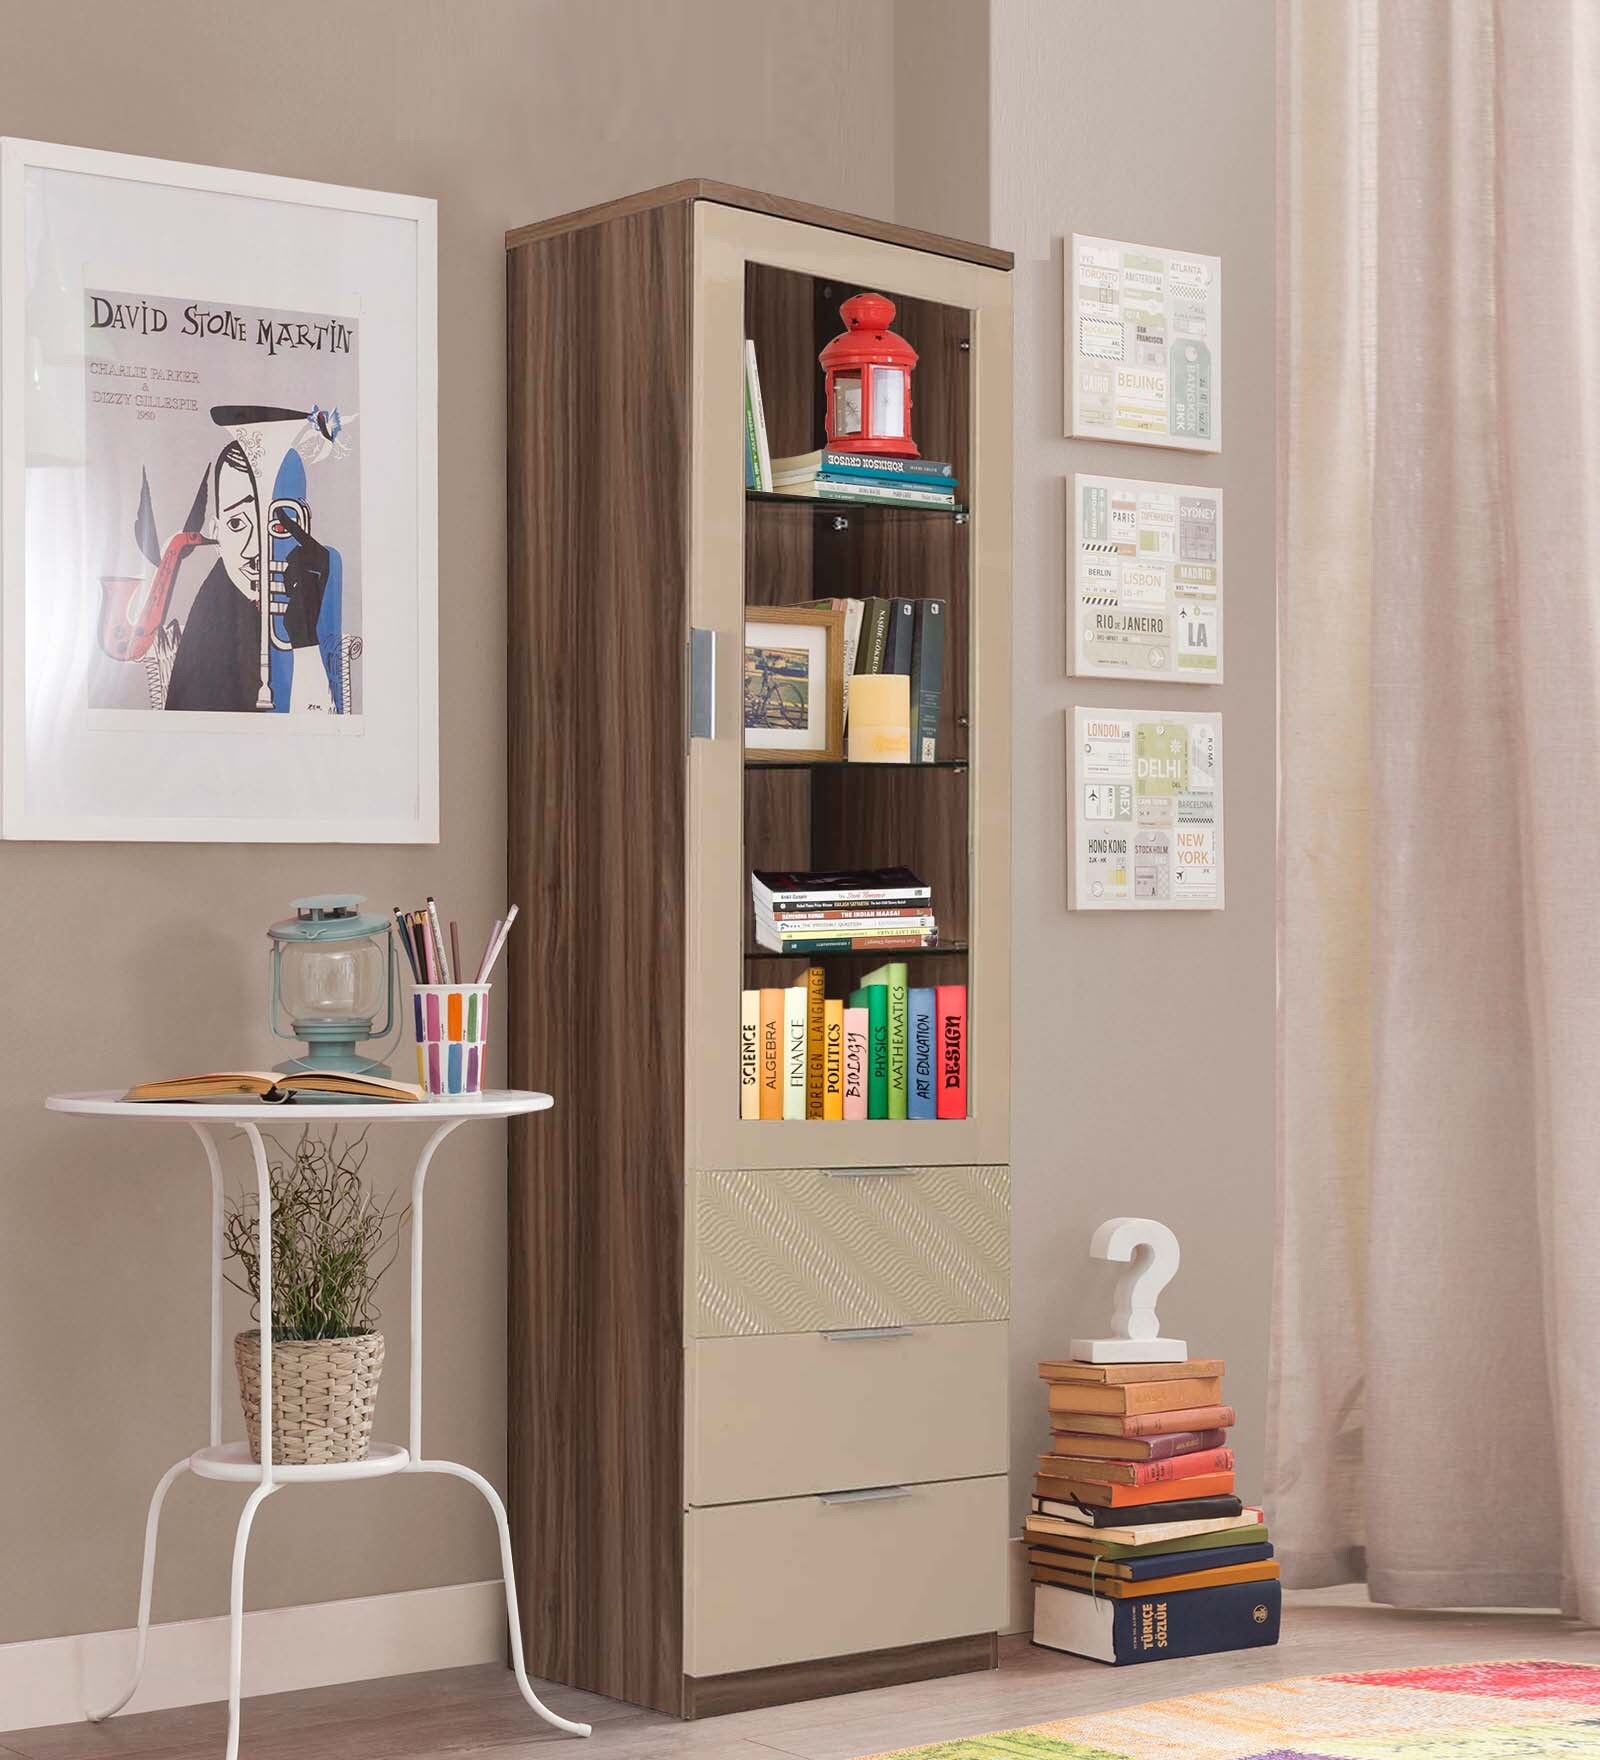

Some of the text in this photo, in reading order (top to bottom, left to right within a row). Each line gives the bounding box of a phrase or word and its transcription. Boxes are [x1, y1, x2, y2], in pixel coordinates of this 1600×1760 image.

[1080, 267, 1119, 282] TORONTO
[1124, 271, 1163, 285] AMSTERDAM
[1169, 263, 1201, 275] ATLANTA
[90, 362, 200, 384] CHARLIE PARKER
[1118, 372, 1165, 391] BEIJING
[92, 391, 199, 411] DIZZY GILLESPIE
[1176, 403, 1185, 431] BKK
[827, 454, 904, 473] ROBINSON CRUSOE
[1112, 511, 1136, 524] PARIS
[1180, 505, 1216, 520] SYDNEY
[1088, 567, 1112, 577] BERLIN
[1122, 573, 1162, 587] LISBON
[1096, 614, 1114, 630] RIO
[1122, 616, 1164, 633] JANEIRO
[1188, 622, 1208, 648] LA
[1087, 723, 1120, 738] LONDON
[1137, 758, 1182, 779] DELHI
[1119, 785, 1131, 816] MEX
[1177, 800, 1213, 809] BARCELONA
[1088, 839, 1127, 854] HONG KONG
[1134, 845, 1169, 855] STOCKHOLM
[1177, 833, 1205, 847] NEW
[1177, 851, 1208, 864] YORK
[810, 968, 825, 1119] FOREIGN LANGUAGE
[893, 986, 905, 1090] MATHEMATICS
[742, 1024, 756, 1086] SCIENCE
[765, 1020, 777, 1090] ALGEBRA
[790, 1018, 805, 1087] FINANCE
[827, 1023, 840, 1094] POLITICS
[874, 1025, 886, 1078] PHYSICS
[916, 1014, 930, 1100] ART EDUCATION
[945, 1015, 962, 1089] DESIGN
[845, 1032, 867, 1098] BIOLOGY
[1140, 1603, 1154, 1650] TÜRKÇE
[1154, 1602, 1168, 1648] SÖZLÜK
